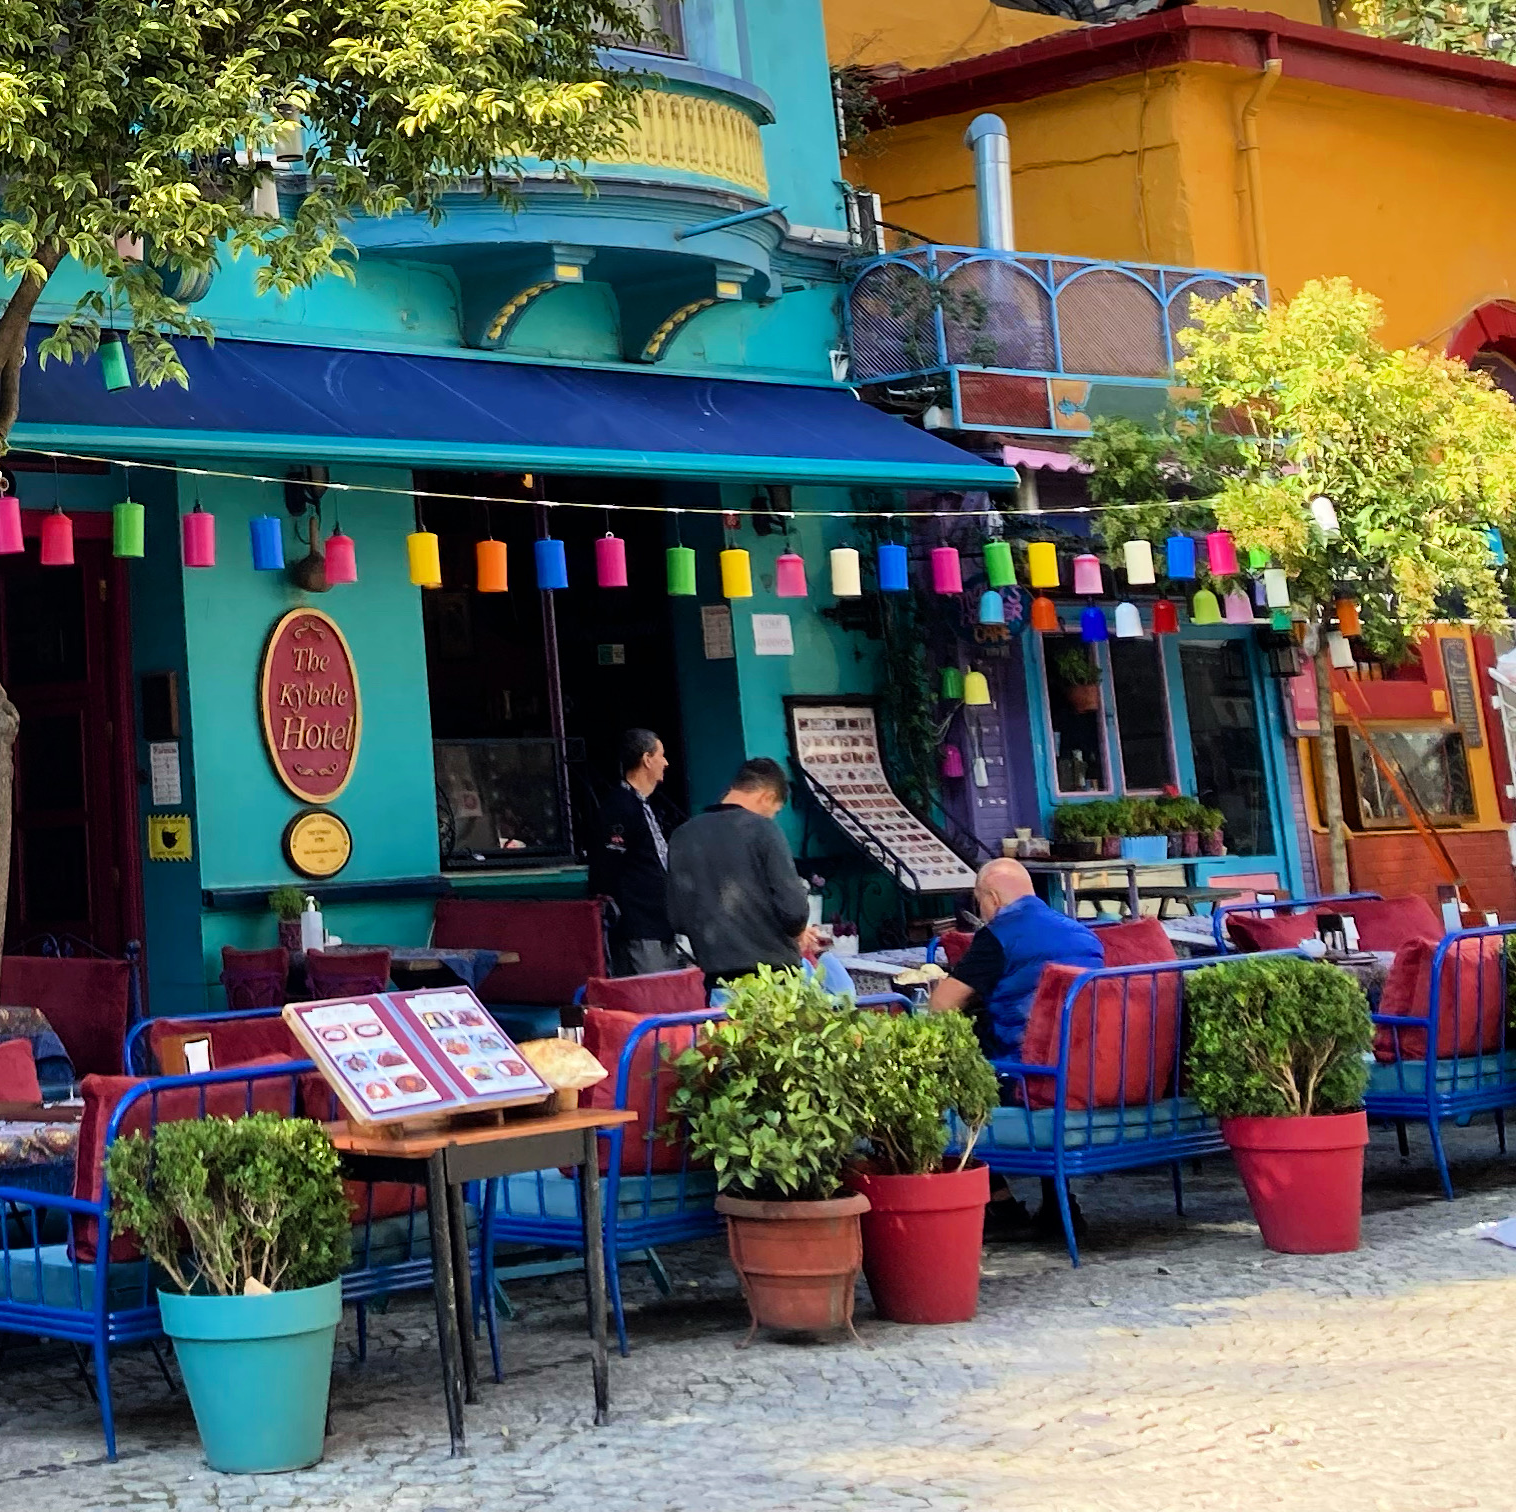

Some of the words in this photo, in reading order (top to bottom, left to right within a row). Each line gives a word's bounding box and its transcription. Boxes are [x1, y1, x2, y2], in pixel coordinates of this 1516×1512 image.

[293, 647, 330, 672] The
[279, 682, 348, 713] Kybele
[281, 715, 354, 751] Hotel
